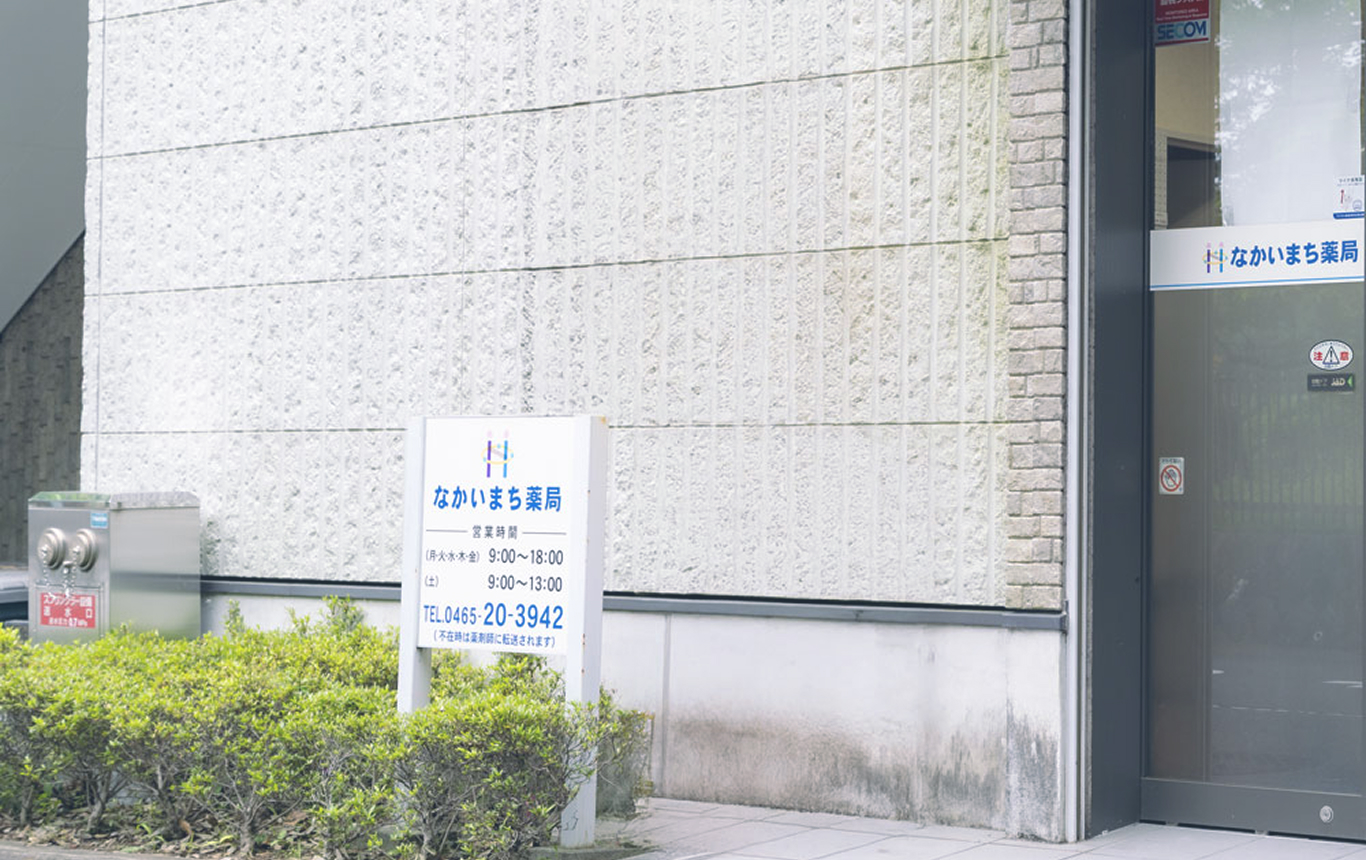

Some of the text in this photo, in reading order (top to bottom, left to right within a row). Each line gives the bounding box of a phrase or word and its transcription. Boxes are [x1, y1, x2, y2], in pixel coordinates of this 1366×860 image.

[1158, 21, 1206, 40] SECOM
[1230, 240, 1358, 268] なかいまち薬局
[433, 485, 562, 512] なかいまち薬局
[472, 525, 518, 540] 営業時間
[424, 575, 439, 588] (土)
[423, 602, 564, 629] TEL.0465-20-3942
